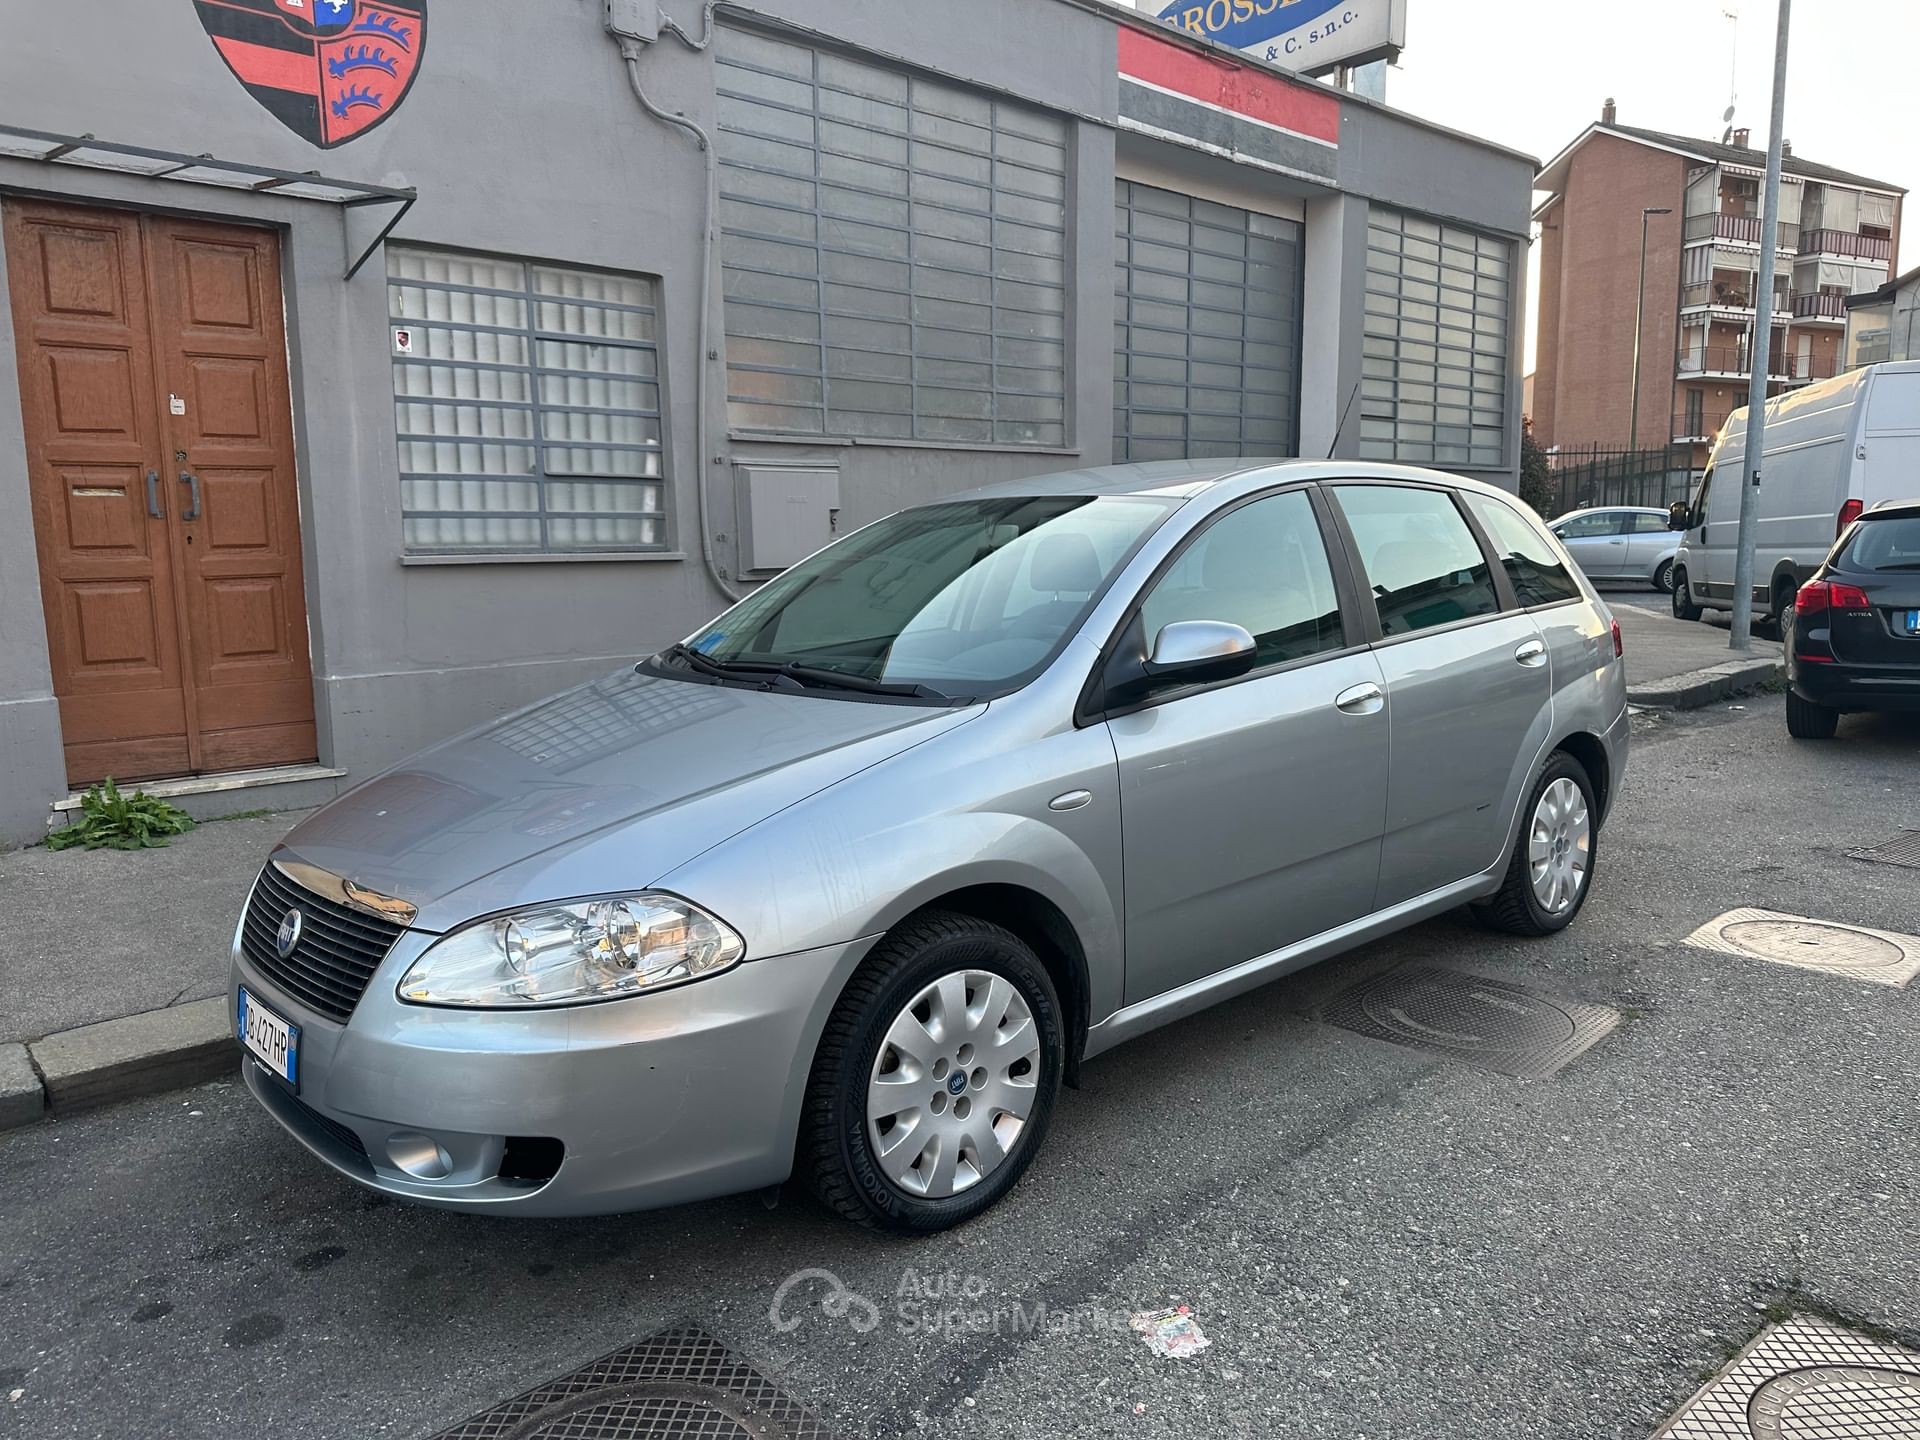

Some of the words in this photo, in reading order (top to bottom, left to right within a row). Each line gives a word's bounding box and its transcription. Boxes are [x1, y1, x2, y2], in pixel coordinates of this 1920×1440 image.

[1164, 0, 1301, 36] ROSS
[1265, 46, 1279, 62] &
[1285, 37, 1302, 53] C.
[1309, 12, 1359, 43] s.n.c.
[951, 1074, 965, 1089] FIAT
[848, 1120, 894, 1211] YOKOHAMA
